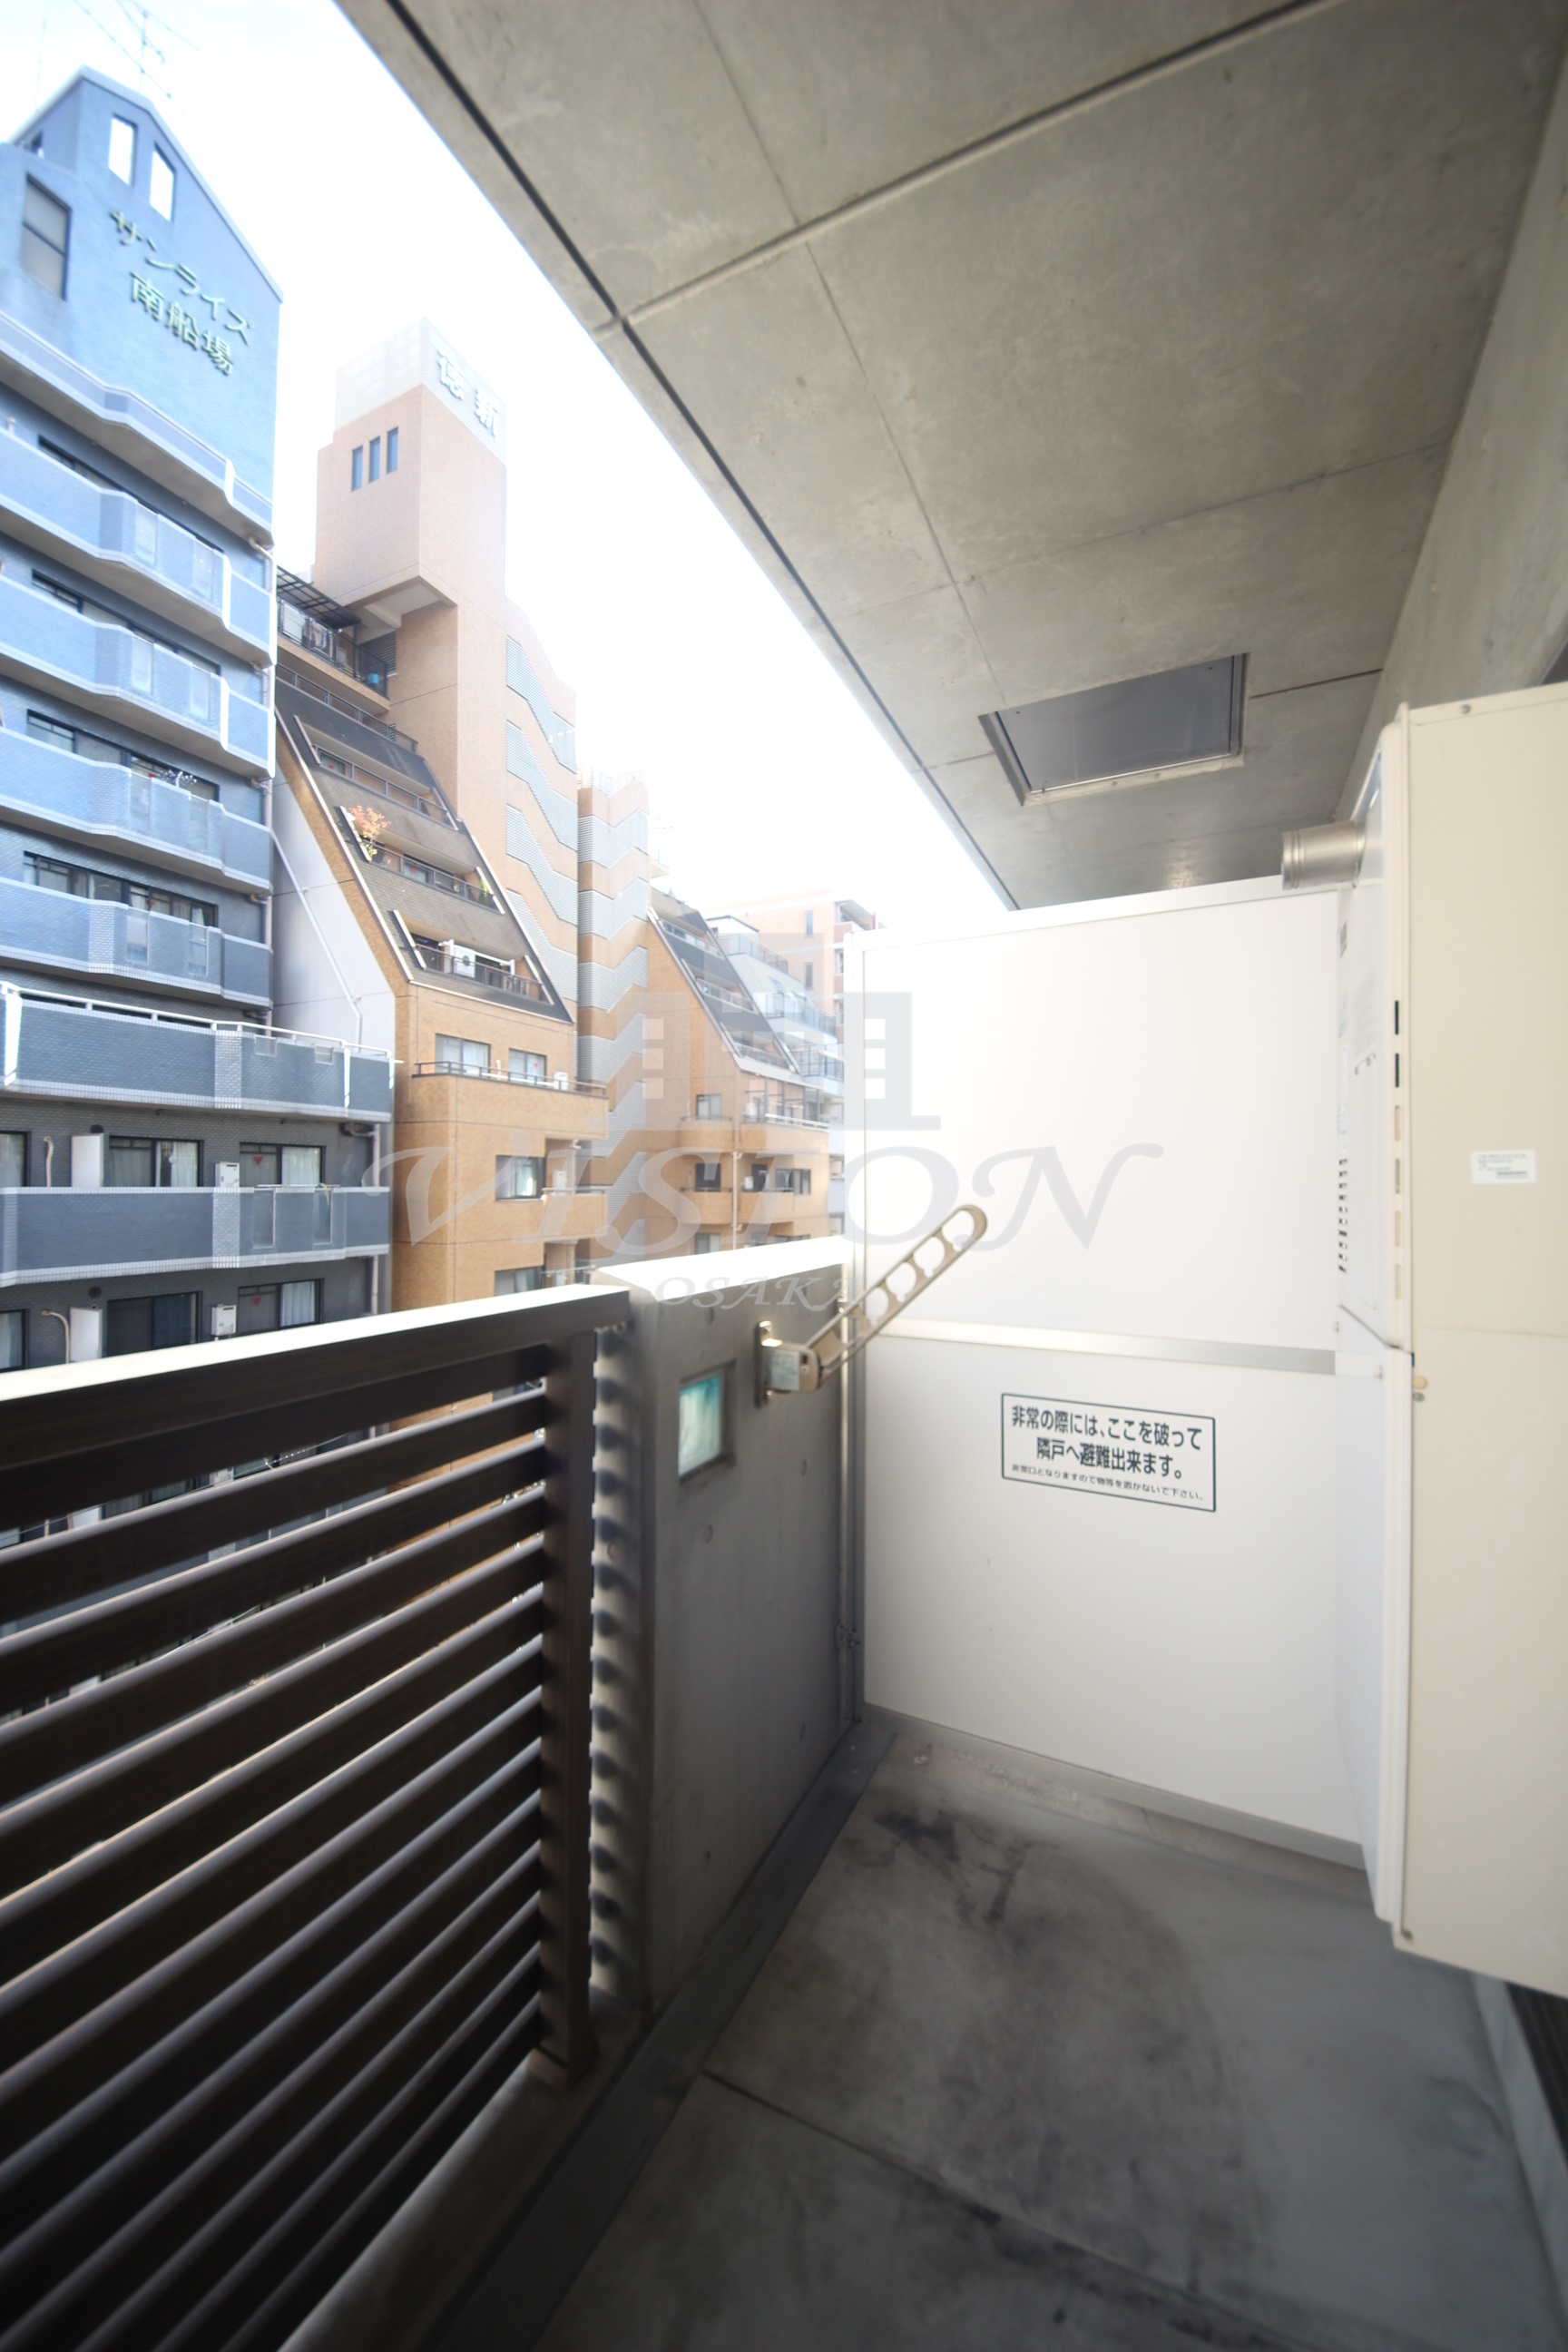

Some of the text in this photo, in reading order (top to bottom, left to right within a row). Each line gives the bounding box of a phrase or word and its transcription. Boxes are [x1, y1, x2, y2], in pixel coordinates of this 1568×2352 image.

[109, 211, 255, 347] サンライズ
[130, 271, 233, 376] 南船場
[1012, 1405, 1202, 1451] 非常の際には、ここを破って
[1036, 1436, 1182, 1479] 隣戸へ避難出来ます。
